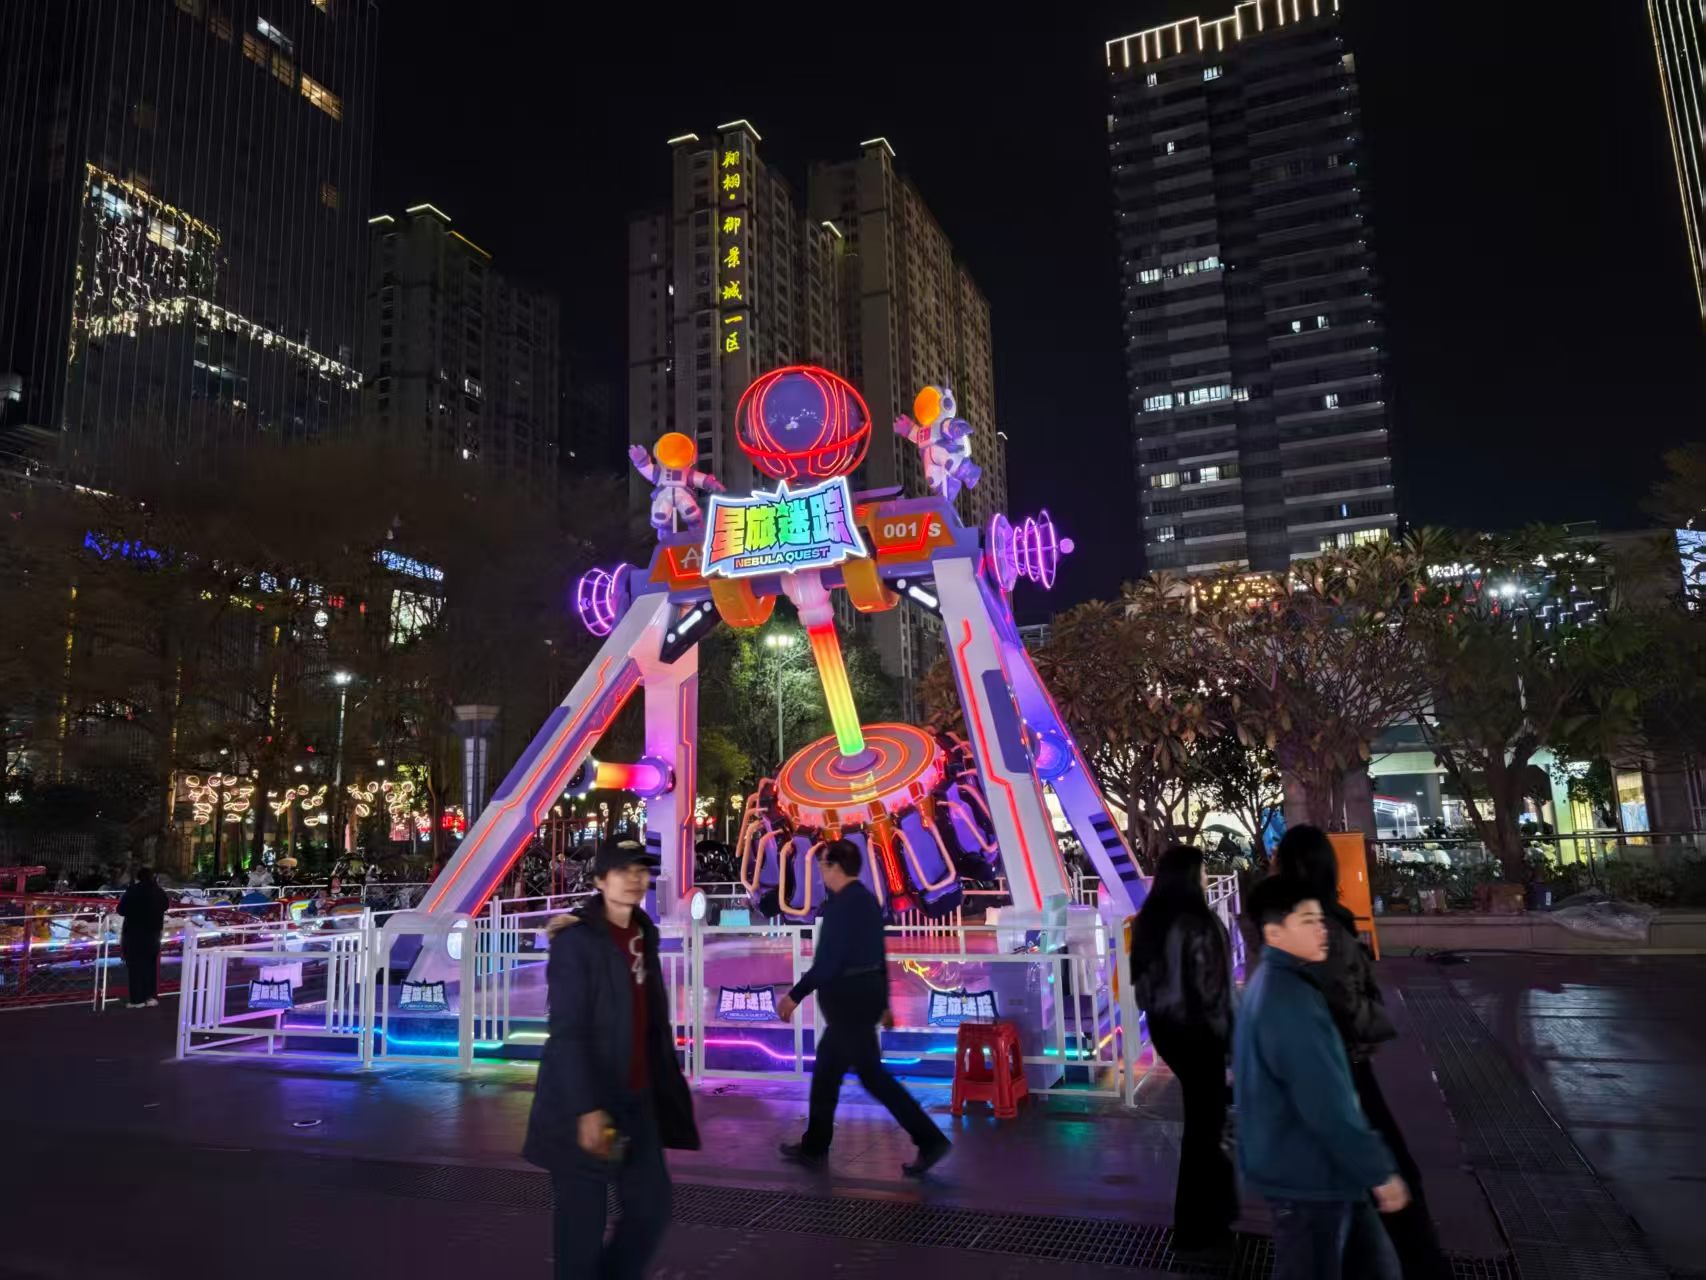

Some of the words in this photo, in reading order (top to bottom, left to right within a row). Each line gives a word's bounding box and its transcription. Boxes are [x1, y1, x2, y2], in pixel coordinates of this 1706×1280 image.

[883, 521, 917, 539] 001
[735, 553, 784, 569] NEBULA
[785, 547, 830, 565] QUEST
